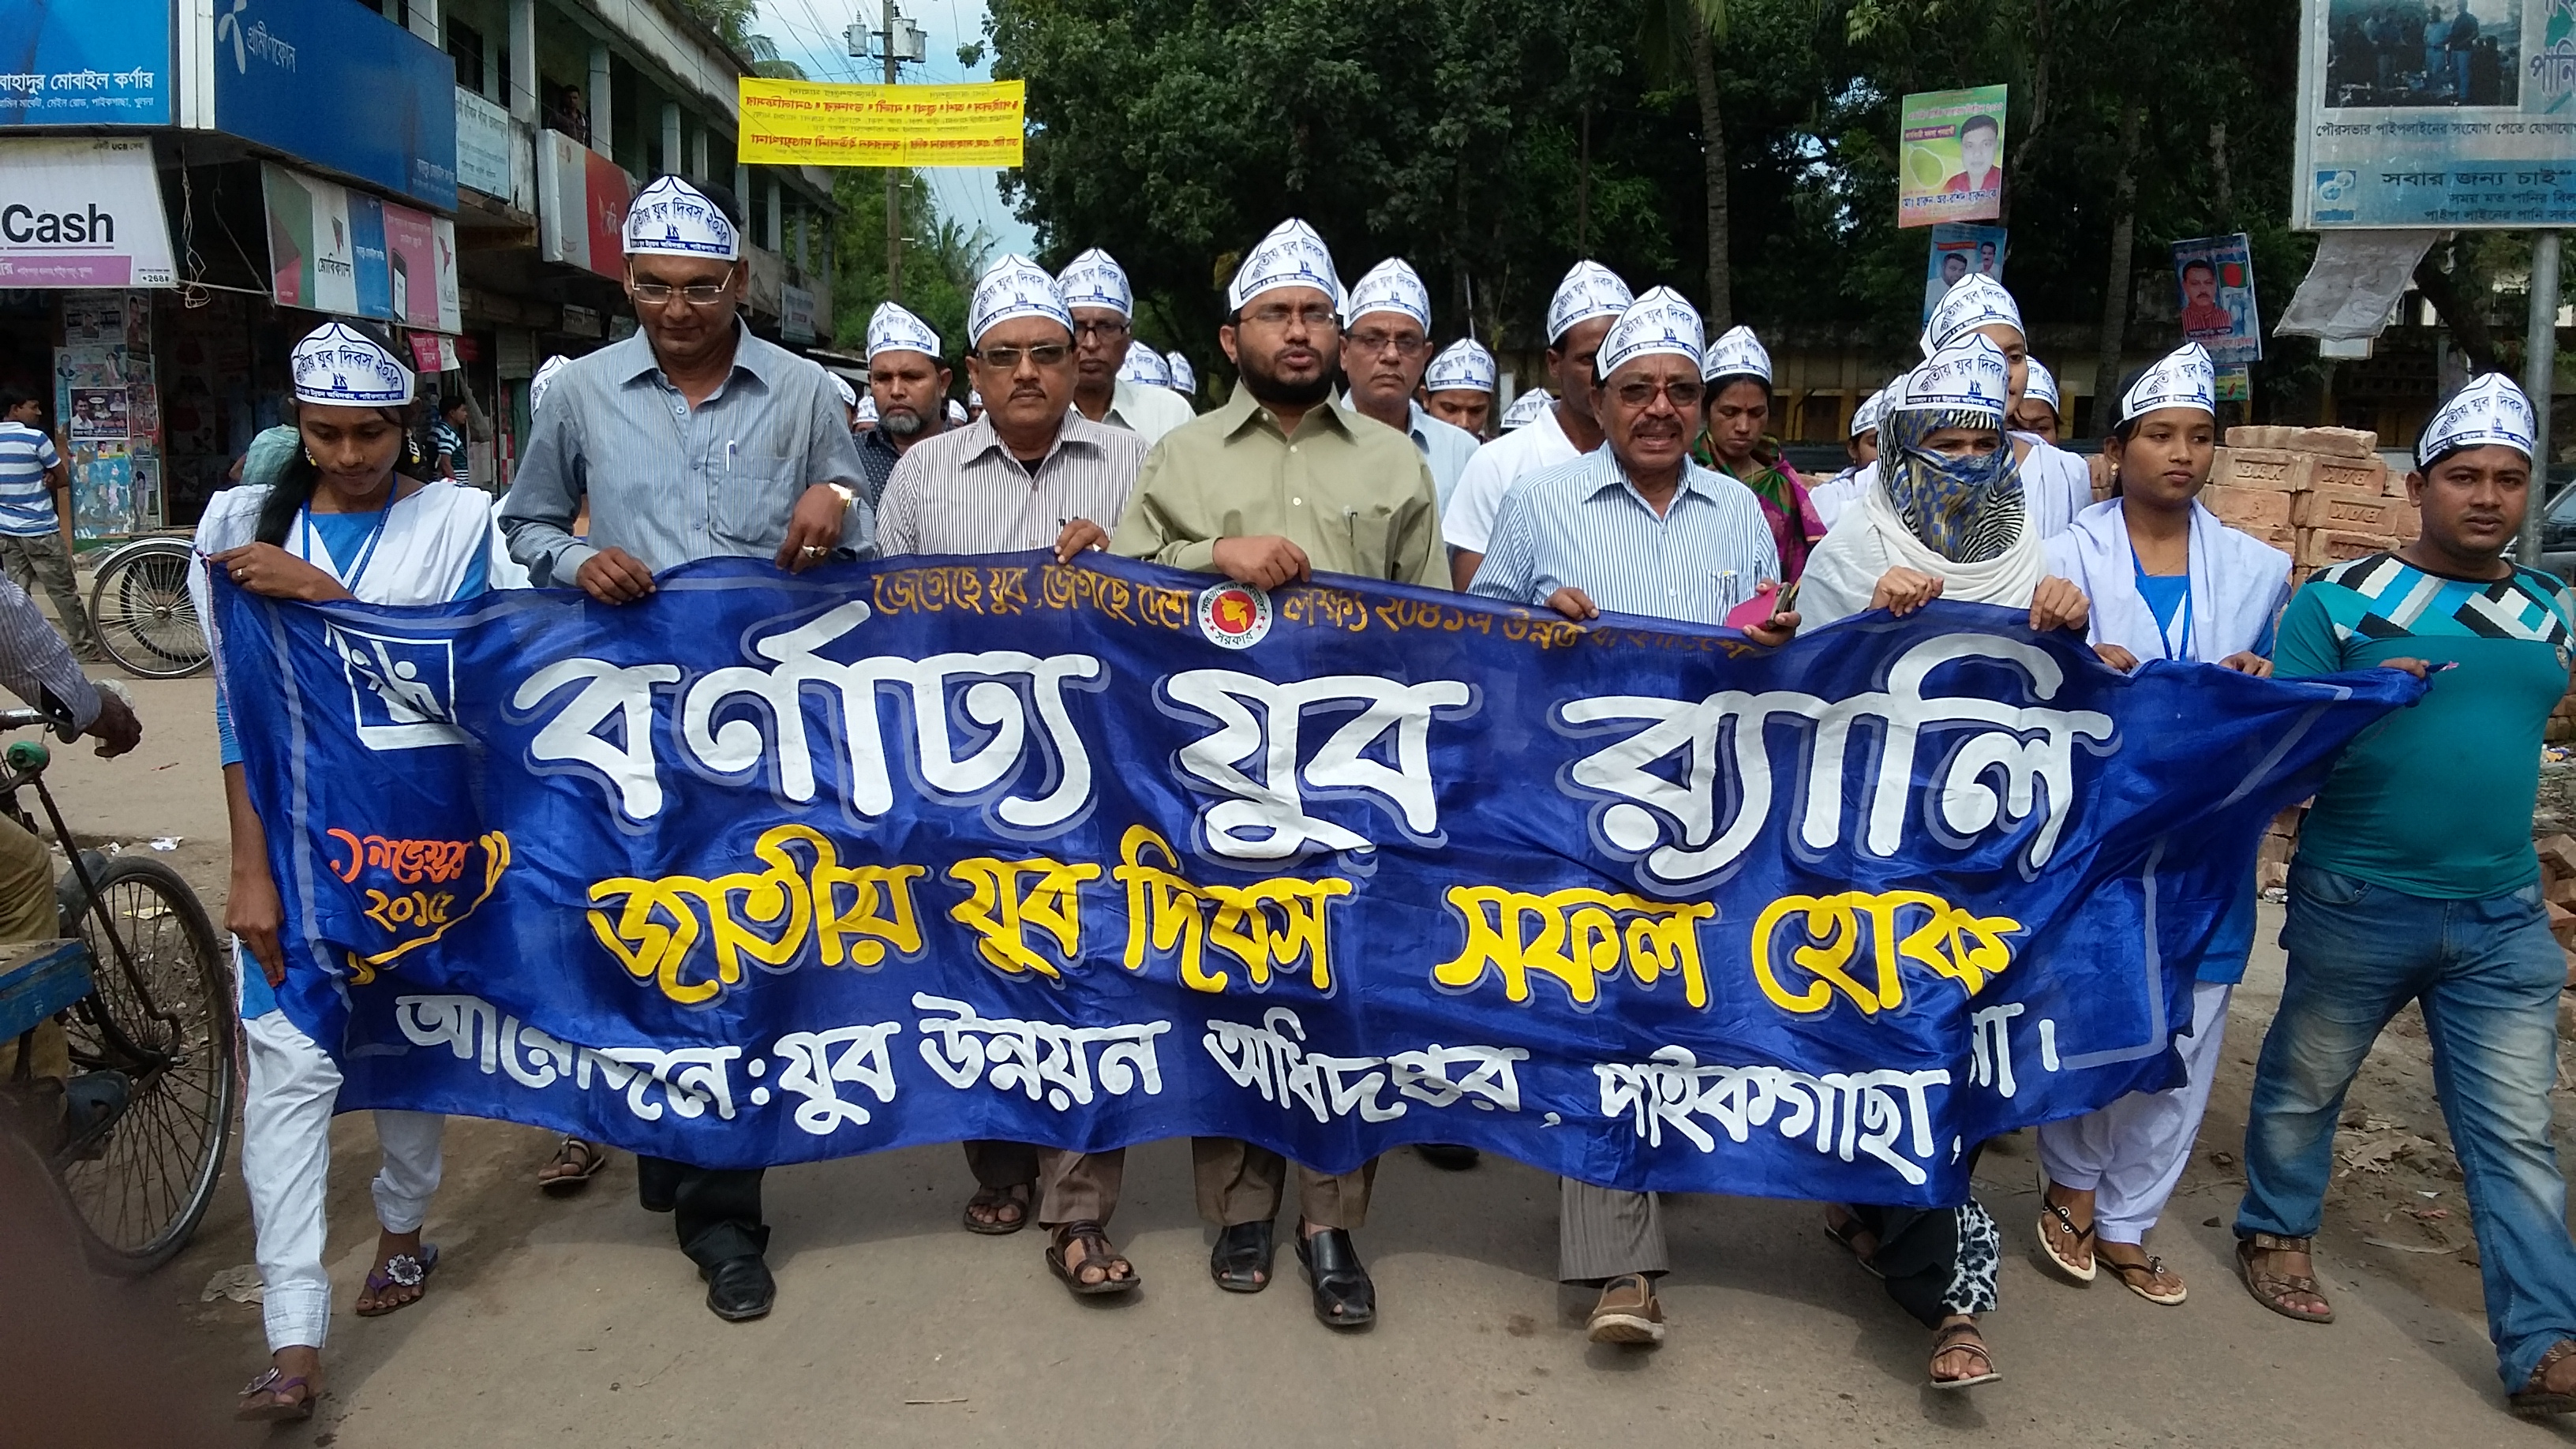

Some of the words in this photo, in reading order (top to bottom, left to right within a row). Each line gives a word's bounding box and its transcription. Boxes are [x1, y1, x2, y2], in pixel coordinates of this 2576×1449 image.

[247, 20, 295, 73] গ্রামীণফোন
[51, 68, 110, 90] মোবাইল
[113, 66, 155, 88] কর্ণার
[2316, 122, 2370, 136] পৌরসভার
[2453, 123, 2490, 135] সংযোগ
[2496, 123, 2525, 135] পেতে
[2529, 123, 2576, 135] যোগাযো
[2381, 173, 2445, 186] সবার
[2454, 173, 2507, 185] জন্য
[652, 202, 668, 219] যুব
[672, 197, 705, 222] দিবস
[2, 203, 114, 243] Cash
[1280, 242, 1297, 256] যুব
[997, 275, 1012, 291] যুব
[1017, 270, 1044, 287] দিবস
[1963, 290, 1979, 303] যুব
[1982, 286, 2005, 300] দিবস
[1645, 309, 1662, 323] যুব
[1667, 304, 1693, 324] দিবস
[316, 350, 335, 369] যুব
[339, 345, 374, 369] দিবস
[1919, 363, 1950, 392] জাতীয়
[1954, 358, 1973, 375] যুব
[1978, 354, 2002, 376] দিবস
[2181, 364, 2197, 377] যুব
[2471, 396, 2490, 414] যুব
[2496, 391, 2523, 415] দিবস
[1136, 582, 1195, 630] দেশ
[1215, 630, 1253, 645] সরকার
[514, 600, 1099, 826] বর্ণাঢ্য
[1166, 669, 1470, 857] যুব
[364, 835, 474, 884] নভেম্বর
[365, 889, 455, 932] ২০১৫
[586, 825, 929, 1002] জাতীয়
[952, 858, 1101, 979] যুব
[1113, 825, 1354, 993] দিবস
[1434, 886, 1717, 1009] সফল
[1753, 890, 2028, 1014] হোক
[773, 1022, 900, 1134] যুব
[912, 991, 1171, 1110] উন্নয়ন
